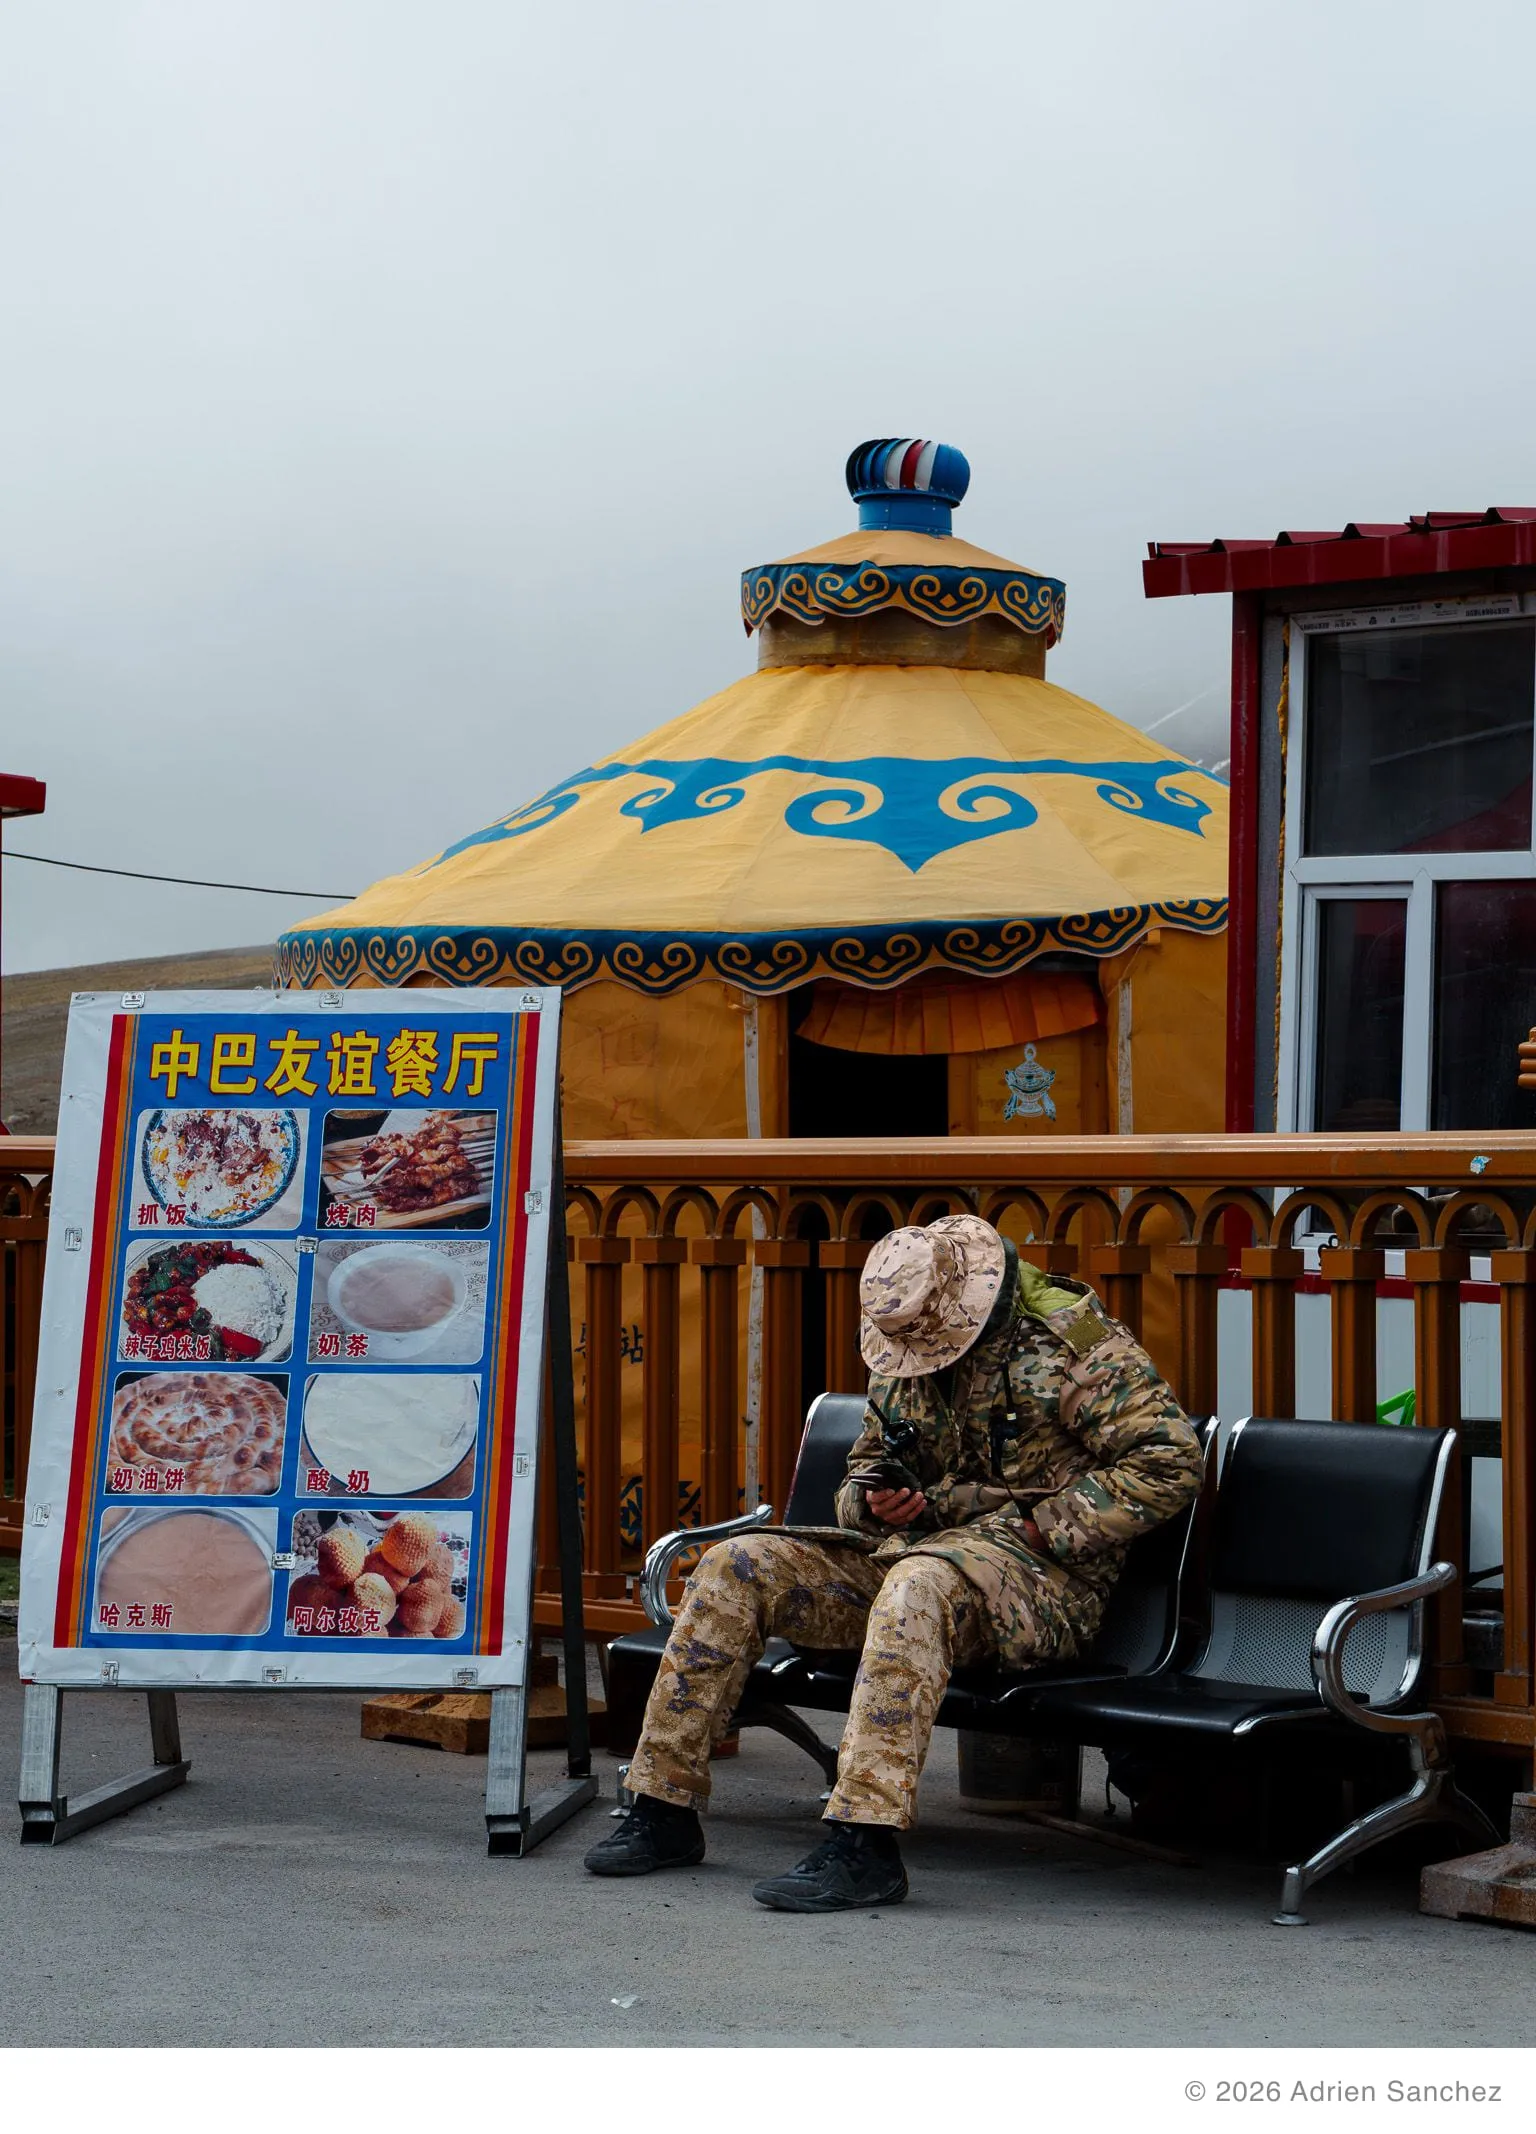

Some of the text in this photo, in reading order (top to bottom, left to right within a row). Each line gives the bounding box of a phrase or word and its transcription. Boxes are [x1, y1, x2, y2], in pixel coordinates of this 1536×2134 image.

[149, 1029, 499, 1098] 中巴友谊餐厅
[137, 1203, 187, 1226] 抓饭
[326, 1203, 377, 1227] 烤肉
[124, 1335, 211, 1359] 辣子鸡米饭
[317, 1333, 370, 1358] 奶茶
[113, 1467, 185, 1491] 奶油饼
[306, 1468, 370, 1492] 酸奶
[99, 1603, 174, 1628] 哈克斯
[293, 1606, 382, 1633] 阿尔孜克
